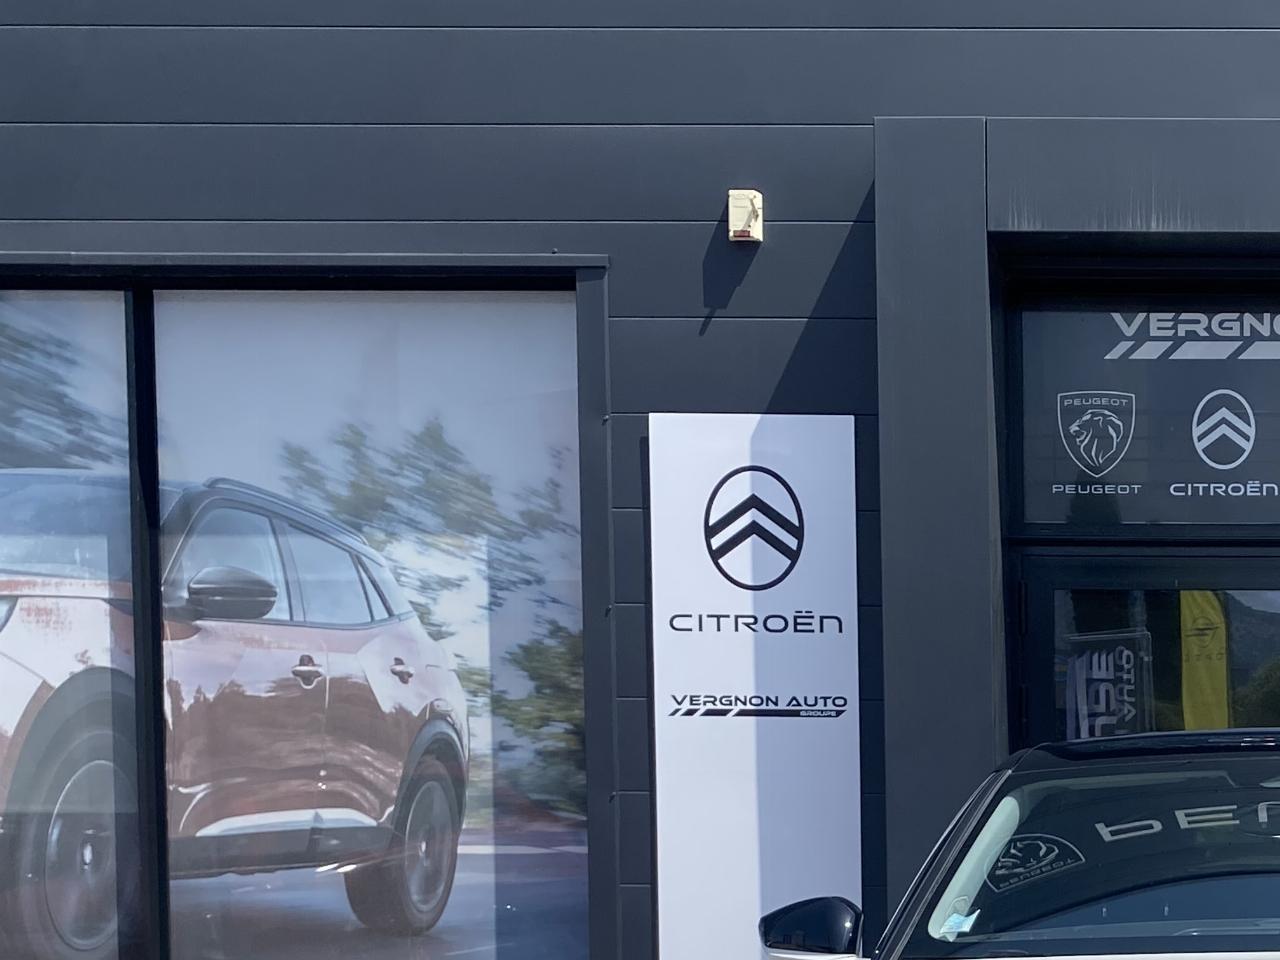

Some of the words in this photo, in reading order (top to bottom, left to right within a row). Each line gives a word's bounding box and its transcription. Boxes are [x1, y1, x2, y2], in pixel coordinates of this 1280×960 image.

[1063, 397, 1129, 408] PEUGEOT
[1052, 483, 1142, 495] PEUGEOT
[670, 694, 780, 708] VERGNON
[785, 694, 848, 708] AUTO
